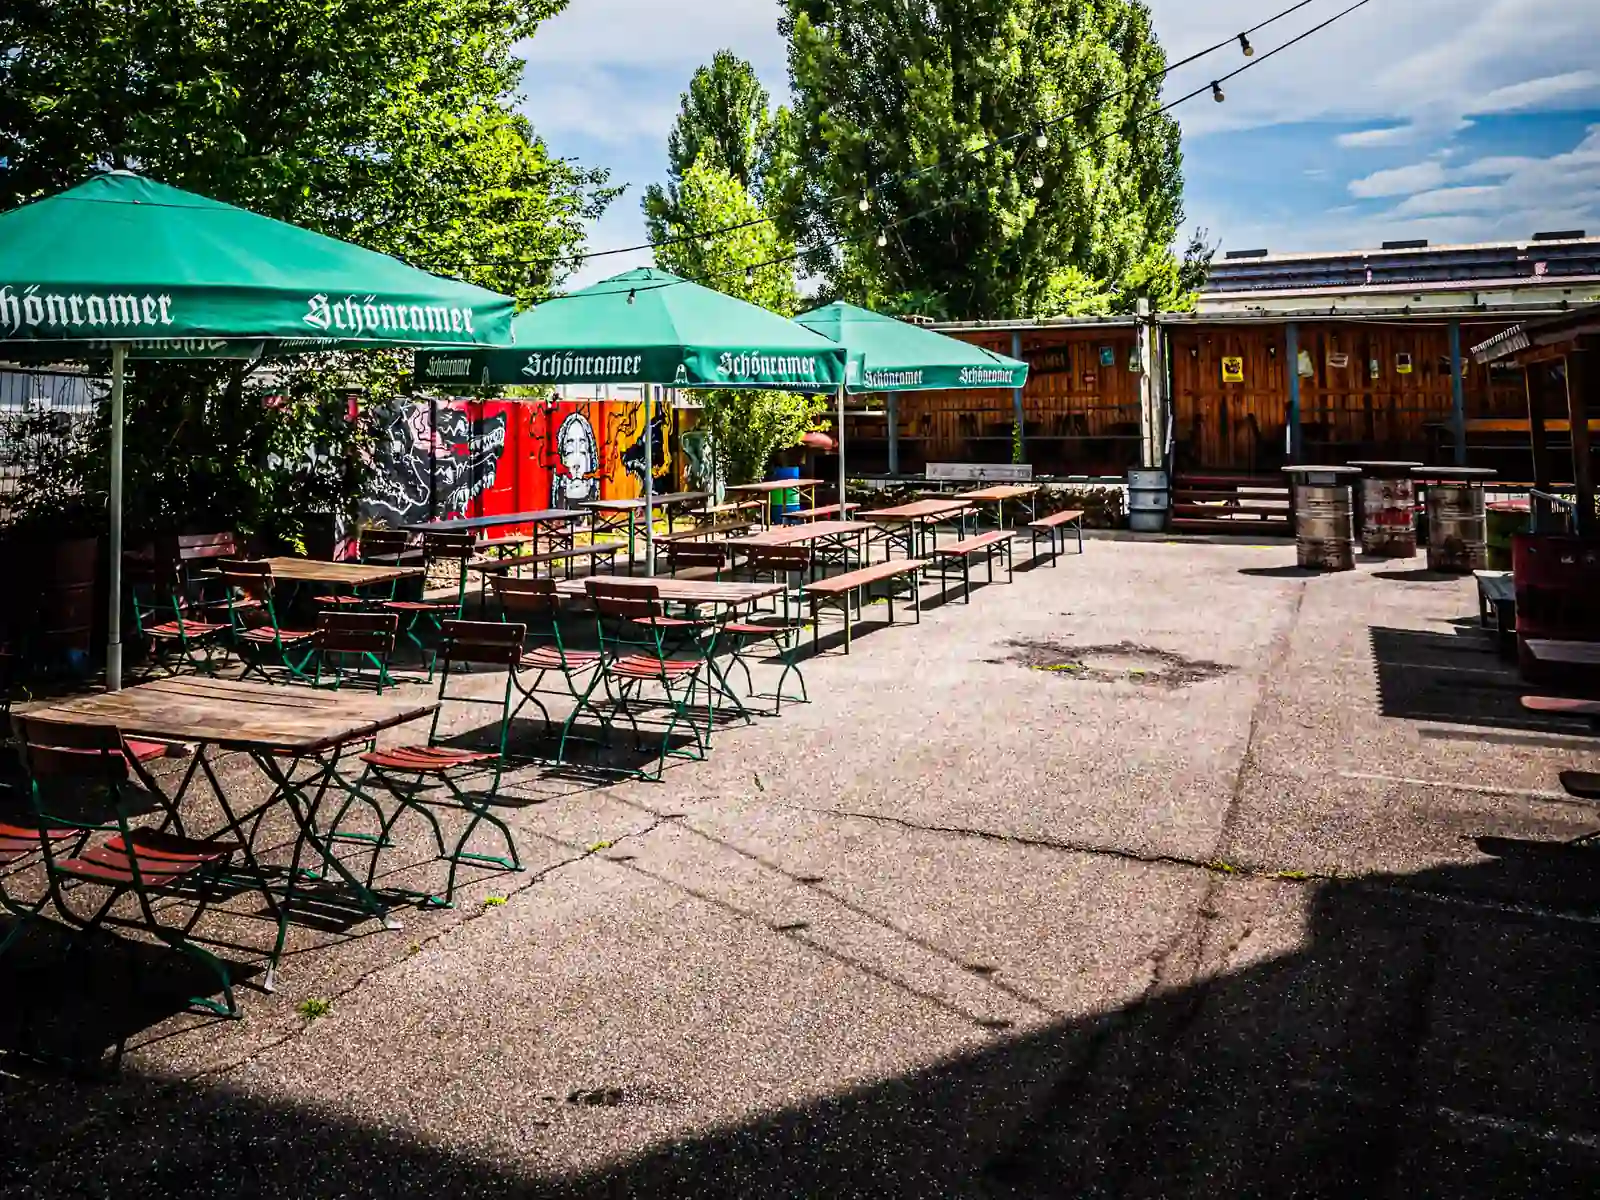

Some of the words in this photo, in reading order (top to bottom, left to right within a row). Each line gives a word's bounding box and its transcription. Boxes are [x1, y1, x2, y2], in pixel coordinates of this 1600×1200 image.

[303, 293, 474, 336] Schönramer
[425, 354, 472, 378] Schönramer
[521, 352, 642, 380] Schönramer
[716, 351, 816, 380] Schönramer
[864, 368, 923, 388] Schönramer
[957, 366, 1013, 385] Schönramer
